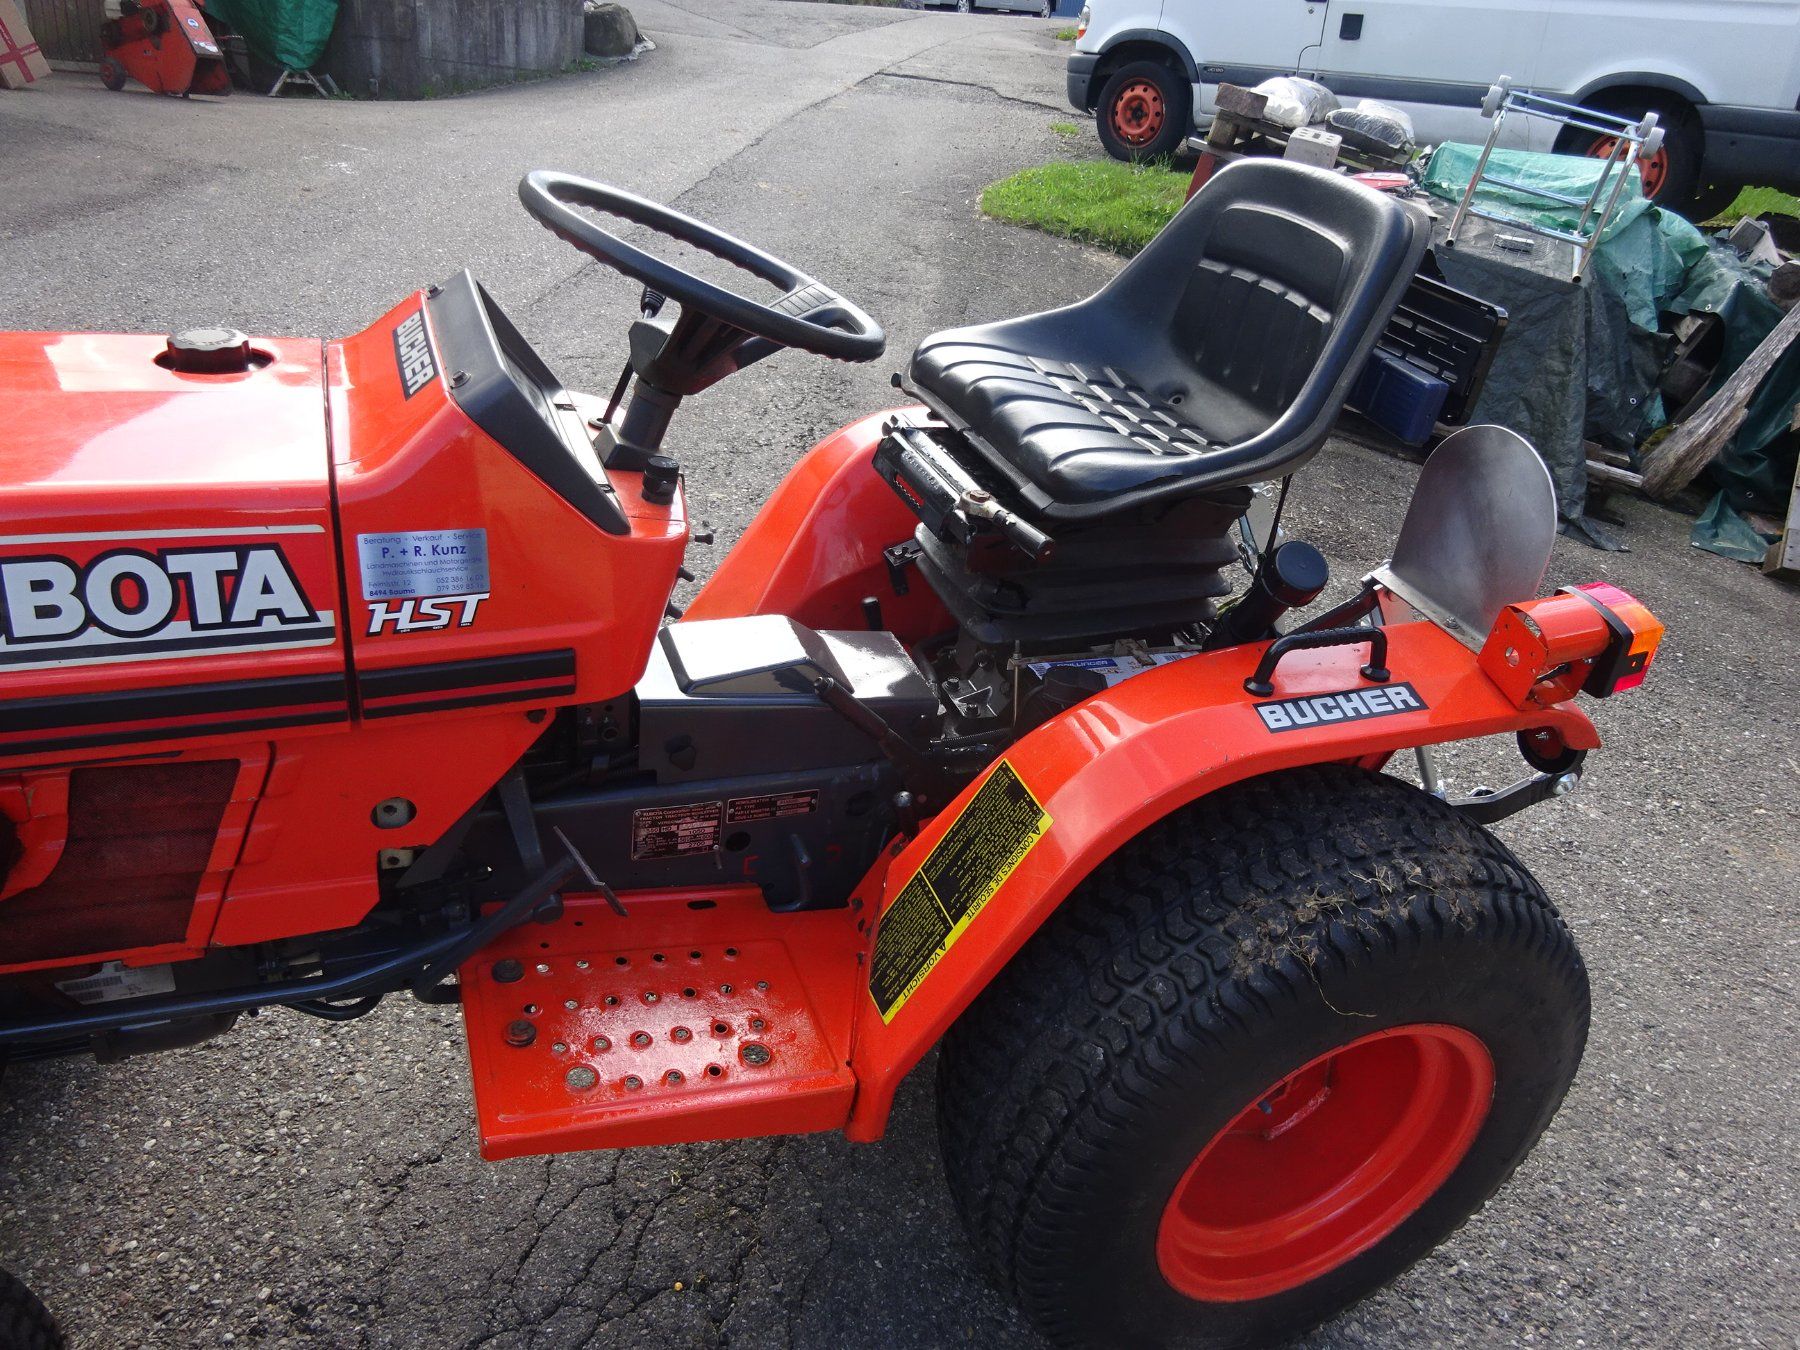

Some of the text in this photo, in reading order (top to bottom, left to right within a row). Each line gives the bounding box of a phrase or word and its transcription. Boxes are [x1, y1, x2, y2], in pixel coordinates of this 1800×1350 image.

[396, 311, 435, 395] BUCHER
[363, 534, 402, 545] Beratung
[411, 534, 443, 543] Verkauf
[381, 547, 395, 558] P.
[414, 546, 427, 557] R.
[432, 544, 467, 556] Kunz
[366, 560, 423, 570] Landmaschinen
[369, 588, 416, 597] 8494 Bauma
[367, 593, 491, 634] HST
[1257, 686, 1420, 729] BUCHER
[964, 835, 1034, 921] CONSIGNES DE SECURITE
[902, 952, 941, 1001] VORSICHT
